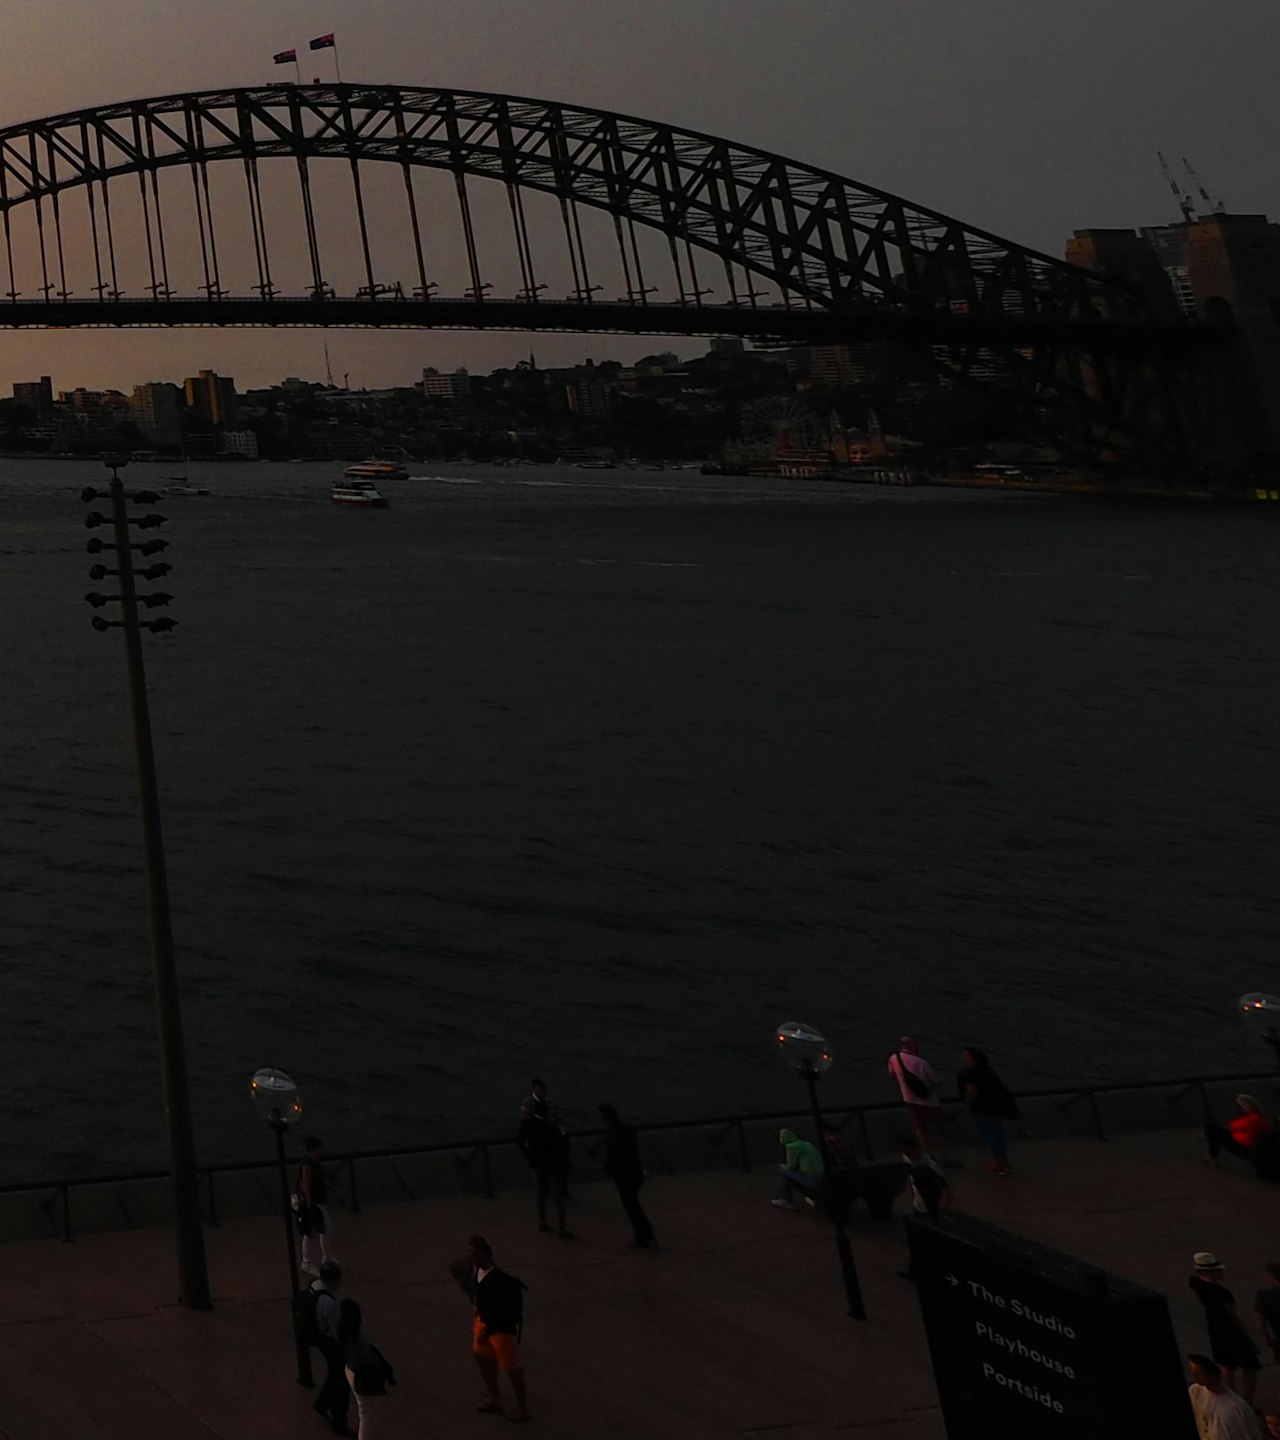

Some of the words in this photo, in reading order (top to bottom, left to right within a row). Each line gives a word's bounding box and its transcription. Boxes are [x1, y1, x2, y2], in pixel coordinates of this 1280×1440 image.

[966, 1278, 1007, 1310] The
[1011, 1298, 1077, 1341] Studio
[974, 1320, 1076, 1381] Playhouse
[982, 1361, 1065, 1415] Portside
